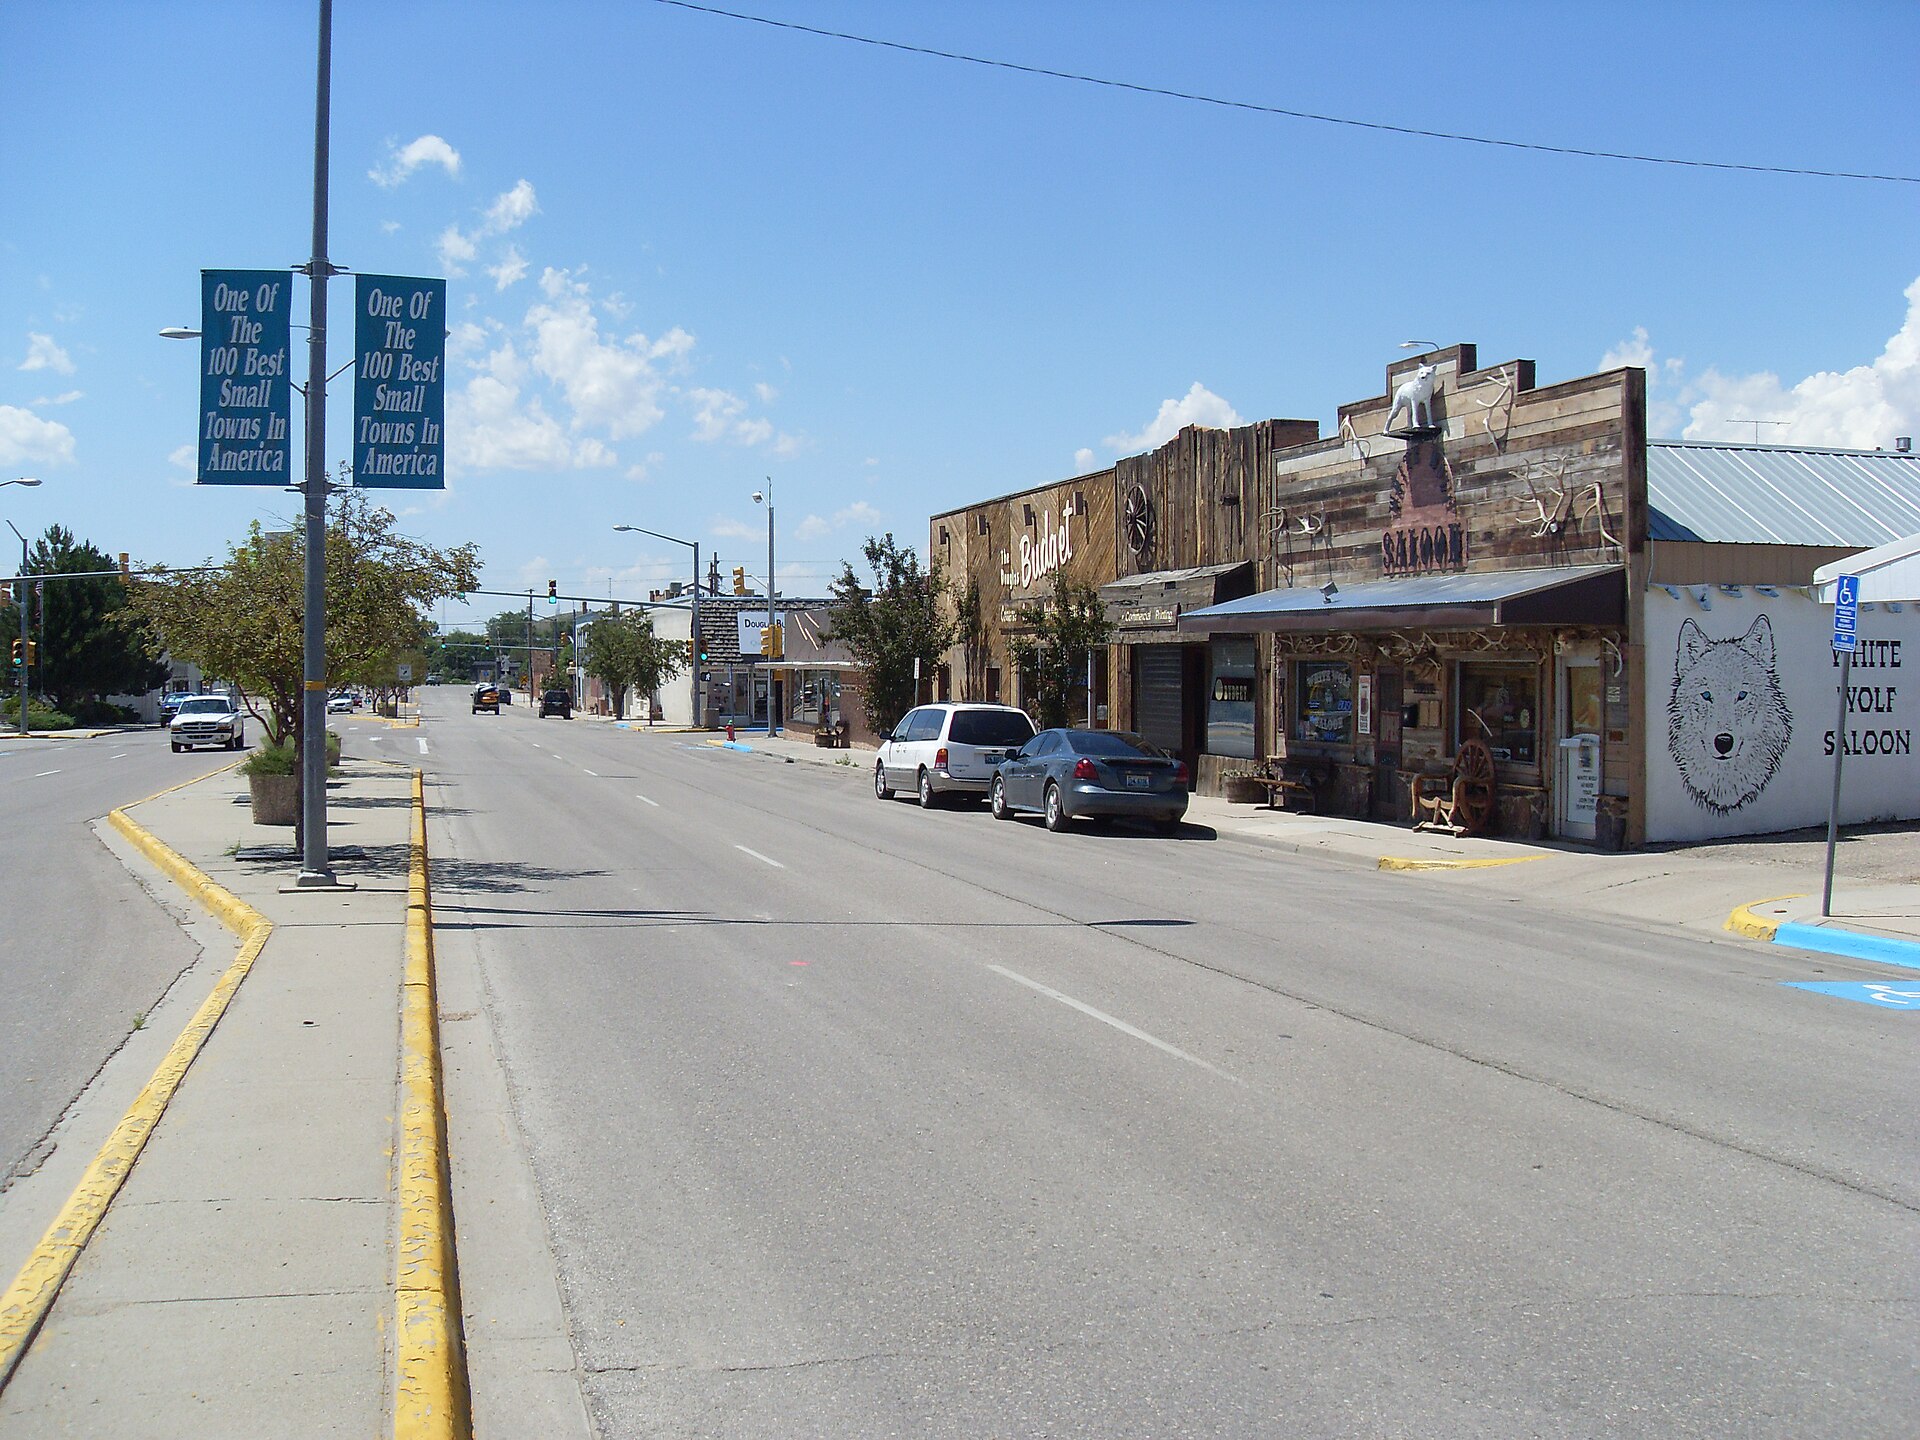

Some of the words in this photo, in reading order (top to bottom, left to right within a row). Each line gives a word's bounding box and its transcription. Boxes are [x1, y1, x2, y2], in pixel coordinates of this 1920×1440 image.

[213, 282, 249, 312] One
[255, 282, 280, 313] Of
[368, 287, 403, 319] One
[409, 291, 433, 320] Of
[229, 315, 262, 344] The
[384, 320, 416, 350] The
[207, 347, 239, 376] 100
[244, 347, 285, 376] Best
[361, 351, 393, 380] 100
[398, 353, 439, 383] Best
[218, 379, 272, 408] Small
[373, 383, 426, 413] Small
[205, 411, 261, 440] Towns
[266, 411, 286, 440] In
[359, 416, 415, 445] Towns
[420, 417, 439, 445] In
[206, 441, 284, 472] America
[361, 445, 438, 475] America
[1019, 500, 1073, 589] Budget
[1383, 523, 1464, 569] SALOON
